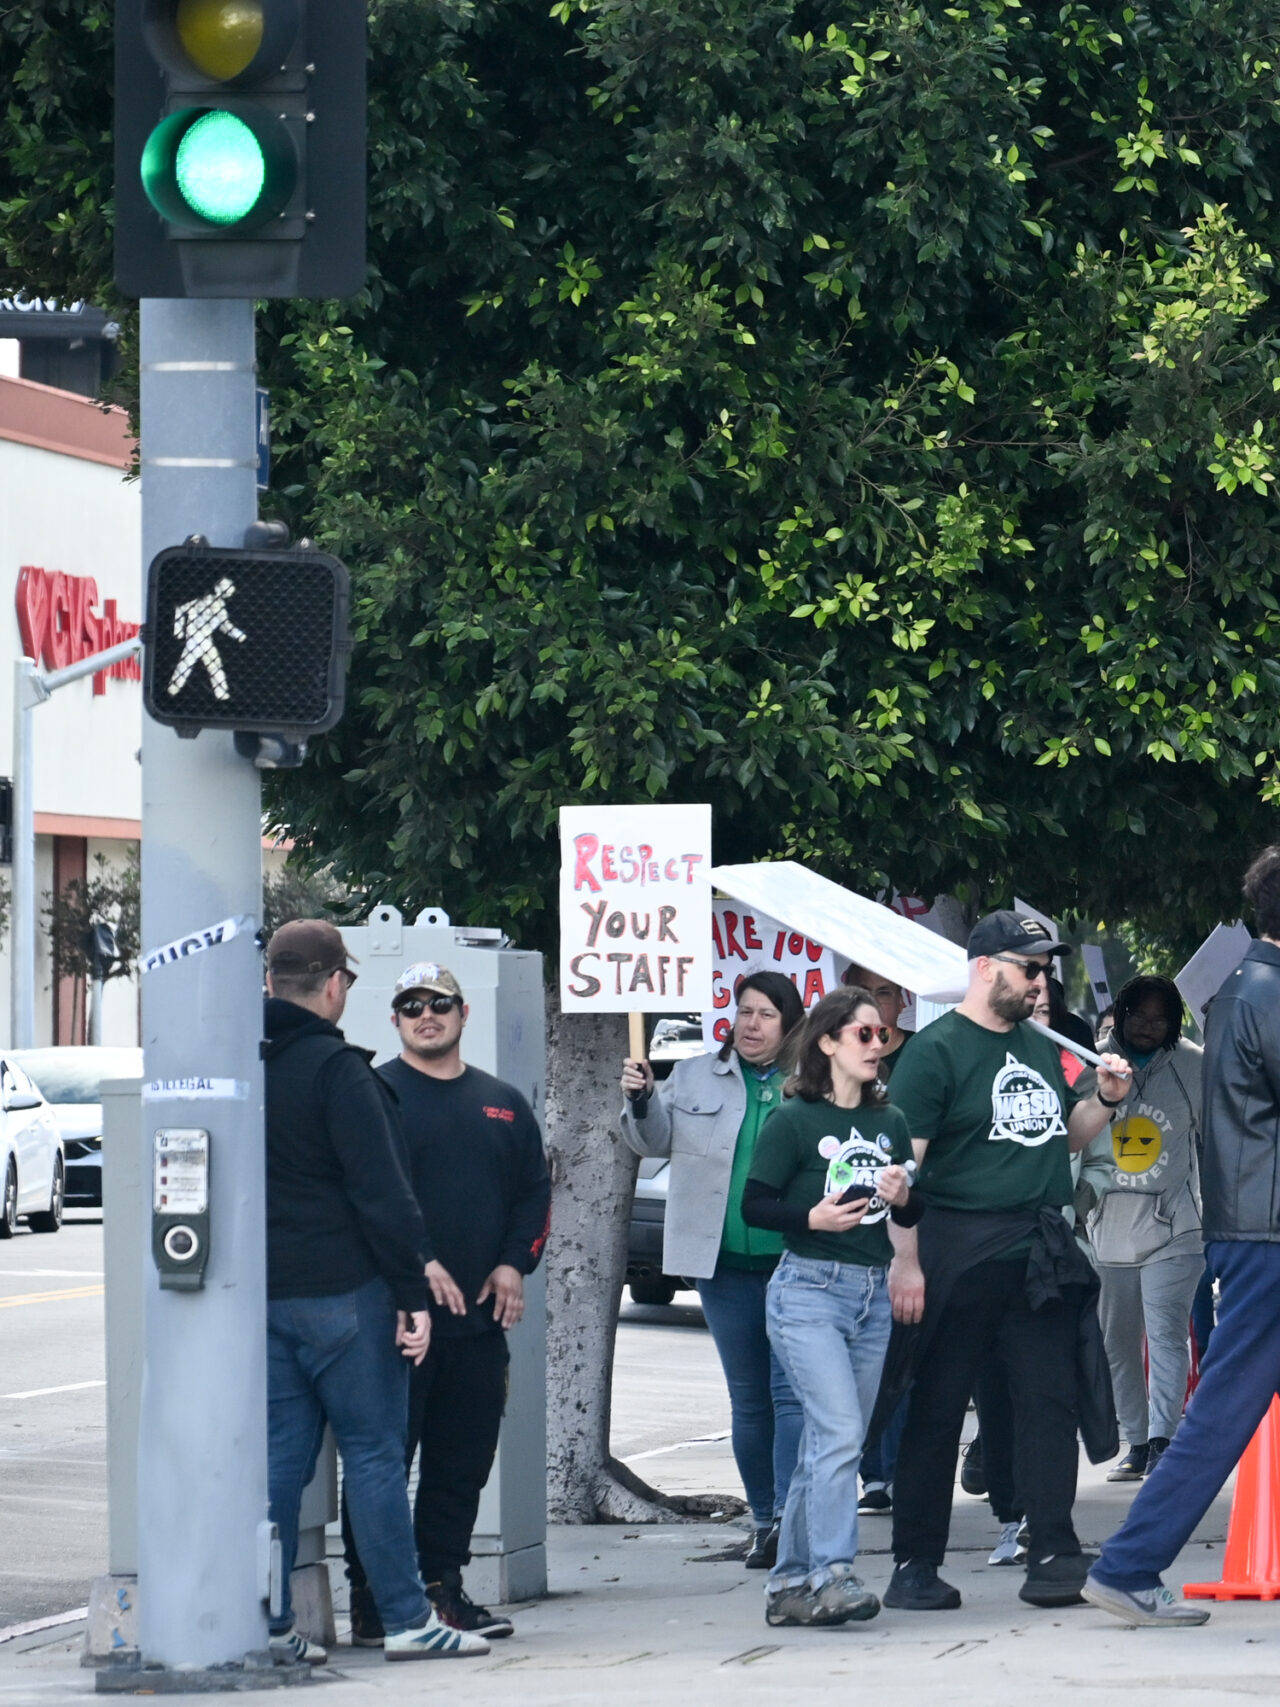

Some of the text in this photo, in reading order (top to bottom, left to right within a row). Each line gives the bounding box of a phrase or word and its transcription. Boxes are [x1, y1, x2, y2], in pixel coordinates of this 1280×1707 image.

[44, 570, 98, 671] CVS
[573, 833, 703, 892] RESPECT
[580, 900, 680, 947] YOUR
[568, 952, 694, 998] STAFF
[162, 1079, 215, 1091] ILLEGAL
[995, 1092, 1059, 1120] WGSU
[1138, 1103, 1173, 1132] NOT
[1009, 1118, 1048, 1133] UNION
[1111, 1151, 1169, 1187] CITED
